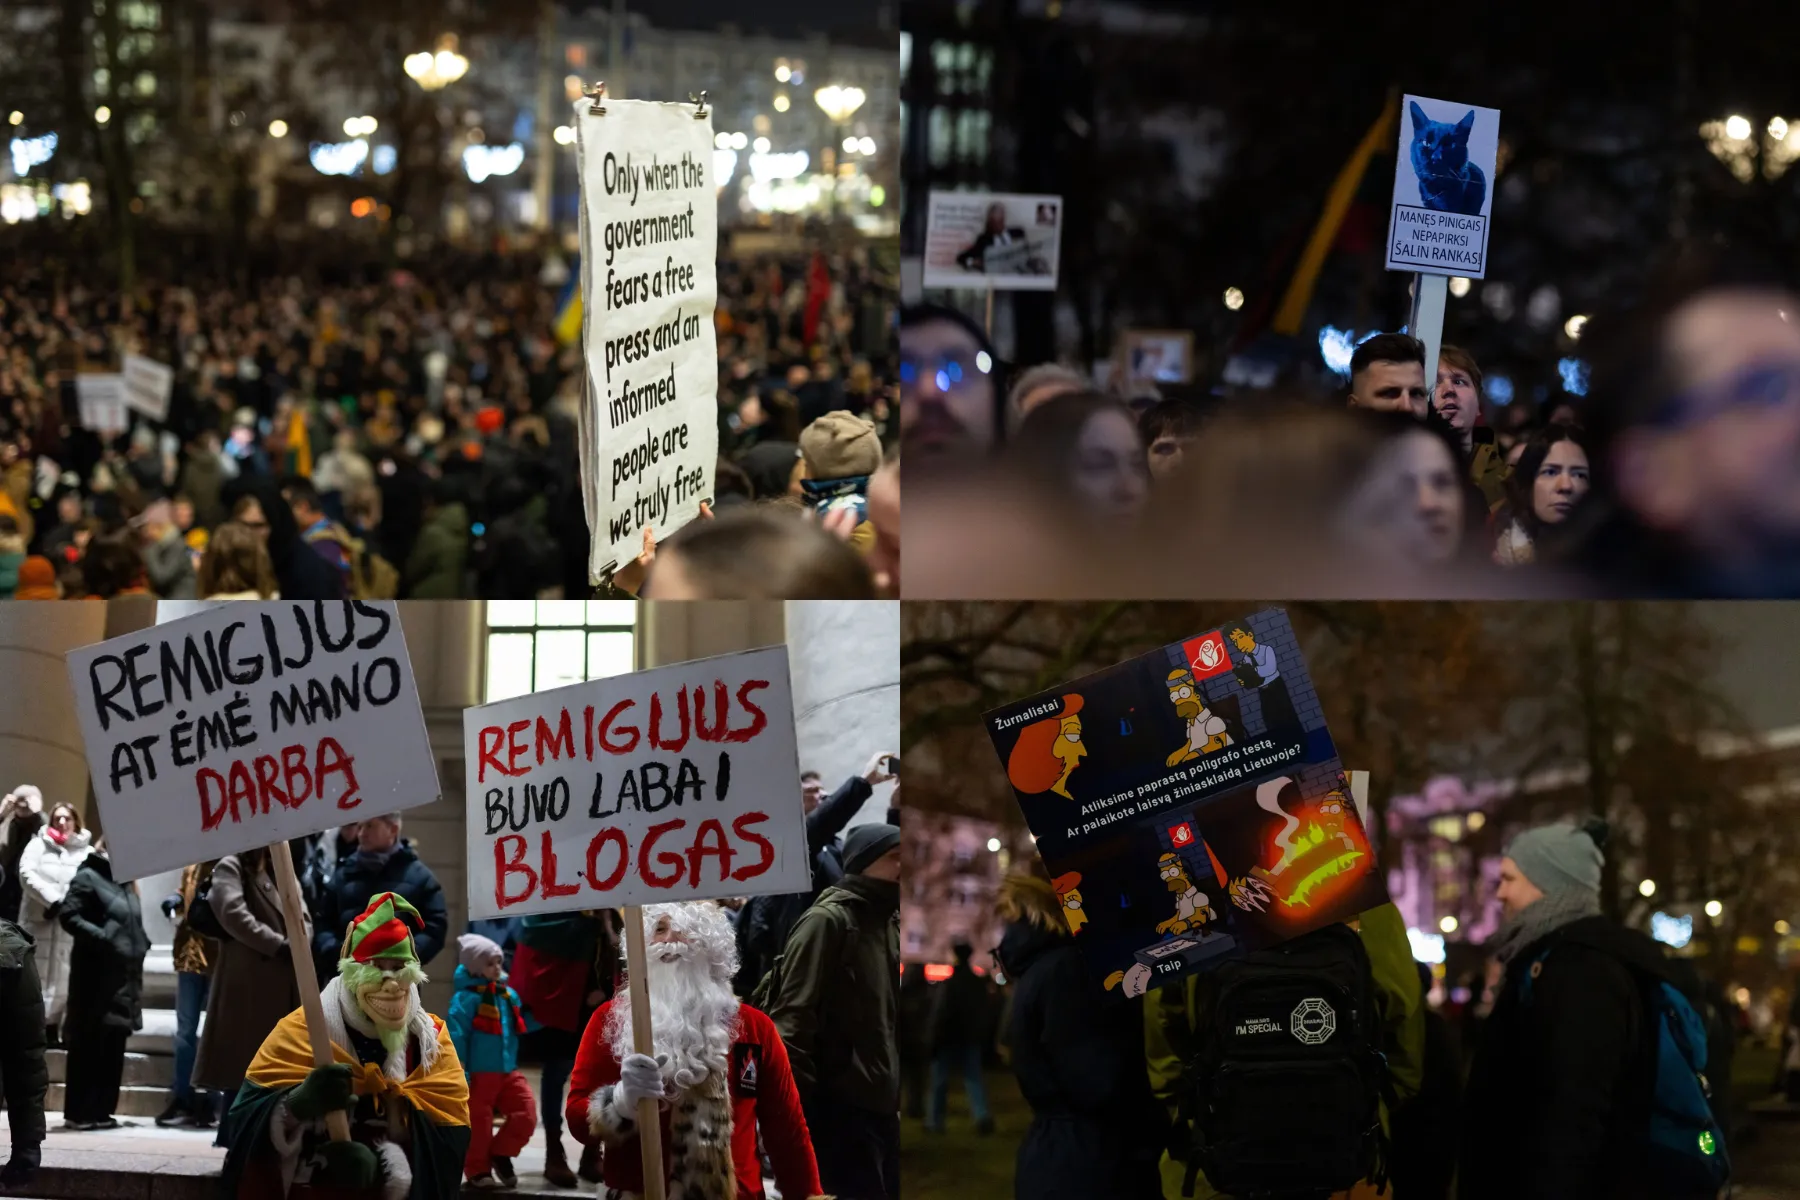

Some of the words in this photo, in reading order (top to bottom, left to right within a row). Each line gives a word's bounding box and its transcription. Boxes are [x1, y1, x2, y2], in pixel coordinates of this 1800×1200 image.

[604, 151, 639, 206] Only
[643, 154, 678, 192] when
[681, 151, 704, 188] the
[604, 202, 694, 266] government
[1394, 240, 1429, 259] ŠALIN
[1431, 247, 1482, 265] RANKAS!
[1400, 210, 1436, 228] MANĘS
[1438, 215, 1481, 232] PINIGAIS
[1412, 229, 1469, 247] NEPAPIRKSI
[605, 268, 648, 311] fears
[653, 272, 662, 298] a
[665, 255, 695, 296] free
[605, 327, 651, 383] press
[653, 308, 680, 352] and
[683, 314, 700, 342] an
[608, 361, 676, 429] informed
[612, 427, 659, 501] people
[662, 423, 688, 457] are
[609, 511, 631, 545] we
[635, 476, 670, 529] truly
[674, 465, 706, 505] free.
[89, 600, 391, 731] REMIGIJUS
[270, 656, 401, 733] MANO
[478, 677, 770, 784] REMIGIJUS
[995, 699, 1059, 730] Žurnalistai
[195, 737, 362, 832] DARBĄ
[485, 776, 570, 835] BUVO
[589, 751, 731, 819] LABAI
[1067, 827, 1079, 838] Ar
[1082, 808, 1135, 834] palaikote
[1136, 794, 1172, 812] laisvą
[1173, 768, 1242, 799] žiniasklaidą
[1243, 744, 1301, 773] Lietuvoje?
[1081, 790, 1135, 816] Atliksime
[1136, 771, 1187, 797] paprastą
[1189, 751, 1240, 777] poligrafo
[1242, 739, 1276, 756] testą.
[494, 811, 775, 911] BLOGAS
[1156, 958, 1182, 975] Taip
[1235, 1025, 1247, 1036] I'M
[1248, 1022, 1283, 1034] SPECIAL
